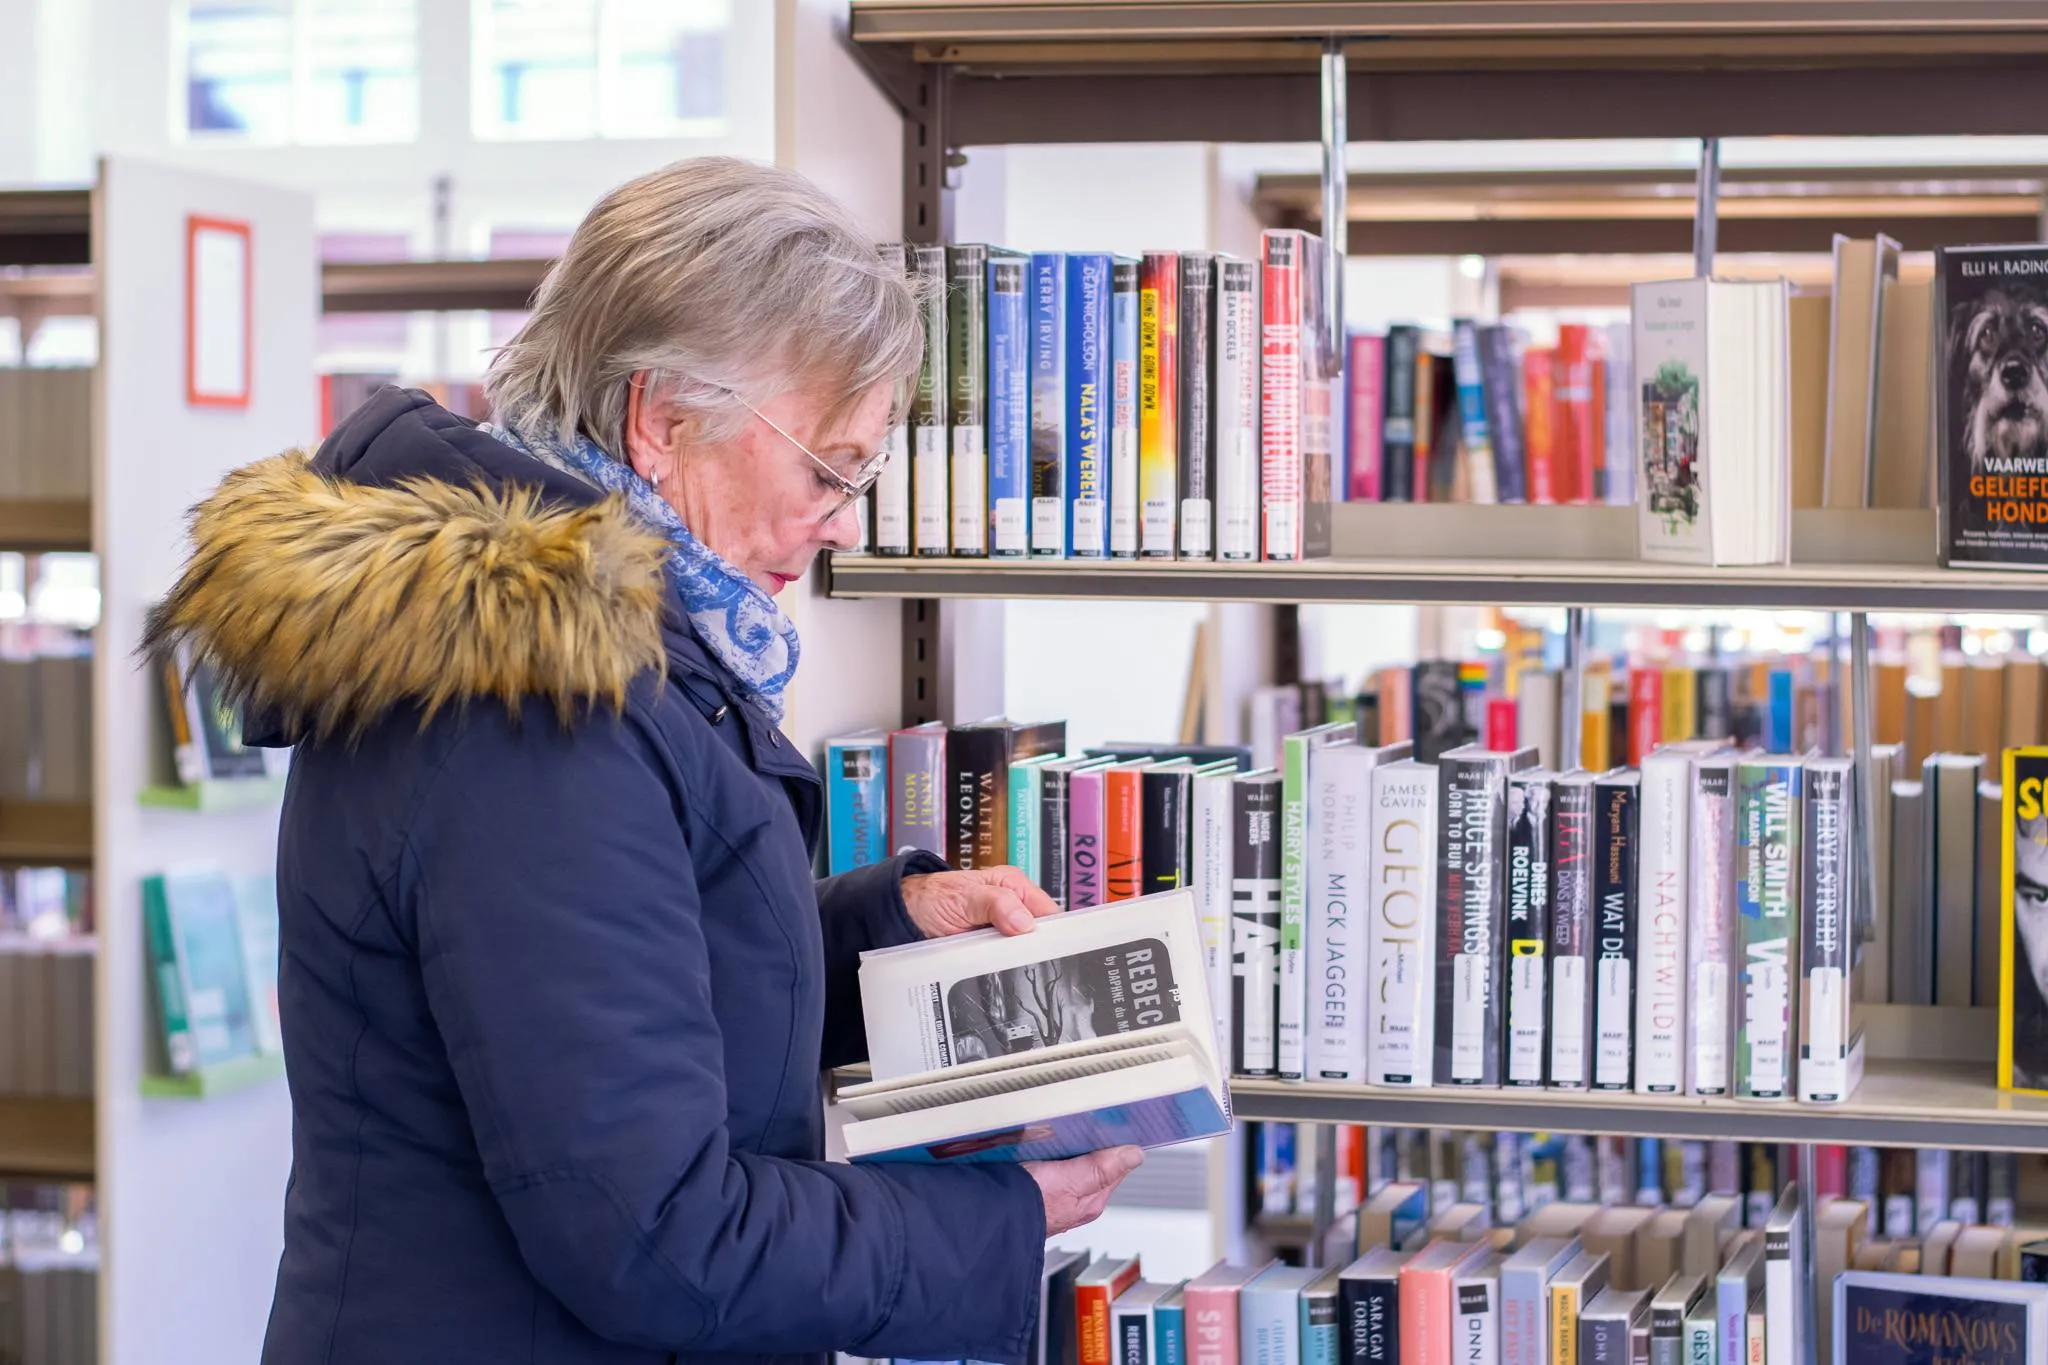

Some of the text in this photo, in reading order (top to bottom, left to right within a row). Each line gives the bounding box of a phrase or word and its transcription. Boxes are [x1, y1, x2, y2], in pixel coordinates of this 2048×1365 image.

[1962, 261, 1985, 275] ELLI
[1039, 267, 1053, 370] KERRY IRVING
[1083, 268, 1096, 371] DEAN NICHOLSON
[1144, 293, 1156, 317] GOING
[1144, 355, 1156, 379] GOING
[1226, 320, 1236, 360] OCKELS
[1080, 384, 1096, 499] NALA'S WEREL
[1263, 354, 1299, 512] DIAMANTENROO
[1984, 458, 2048, 473] VAARWE
[902, 772, 916, 826] MOOIJ
[920, 771, 932, 828] ANNET
[979, 772, 992, 856] WALTER
[1380, 797, 1428, 808] GAVIN
[1382, 784, 1427, 796] JAMES
[852, 792, 870, 864] EEUWIG
[960, 772, 973, 870] LEONARD
[1016, 788, 1027, 871] TATIANA DE ROSNA
[1260, 812, 1270, 842] ANDER
[1322, 783, 1336, 860] NORMAN
[1342, 795, 1355, 850] PHILIP
[1448, 823, 1461, 837] TO
[1608, 791, 1626, 884] Maryam Hassouni
[1749, 811, 1760, 846] MARK
[1075, 834, 1096, 907] RONN
[1285, 800, 1300, 924] HARRY STYLES
[1448, 843, 1461, 868] RUN
[1748, 849, 1760, 902] MANSON
[1764, 782, 1788, 917] WILL SMITH
[1326, 874, 1346, 929] MICK
[1512, 846, 1528, 921] ROELVINK
[1530, 862, 1546, 906] DRIES
[1557, 870, 1570, 900] DANS
[1557, 902, 1570, 913] IK
[1556, 914, 1569, 946] WEER
[1603, 893, 1624, 932] WAT
[1815, 873, 1837, 953] STREEP
[1653, 871, 1676, 1029] NACHTWILD
[1104, 955, 1130, 1033] by DAPHNE du MA
[1125, 948, 1164, 1025] REBEC
[930, 982, 949, 1068] POCKET EDITION COMPLE
[1082, 1315, 1093, 1363] EVARISTO
[1093, 1299, 1104, 1363] BERNARDINE
[1127, 1325, 1140, 1365] REBECC
[1166, 1329, 1176, 1363] MARCO
[1197, 1310, 1222, 1365] SPIE
[1353, 1300, 1368, 1356] FORDEN
[1369, 1296, 1384, 1360] SARA GAY
[1594, 1325, 1607, 1361] JOHN
[1857, 1306, 2017, 1354] De ROMANOVS
